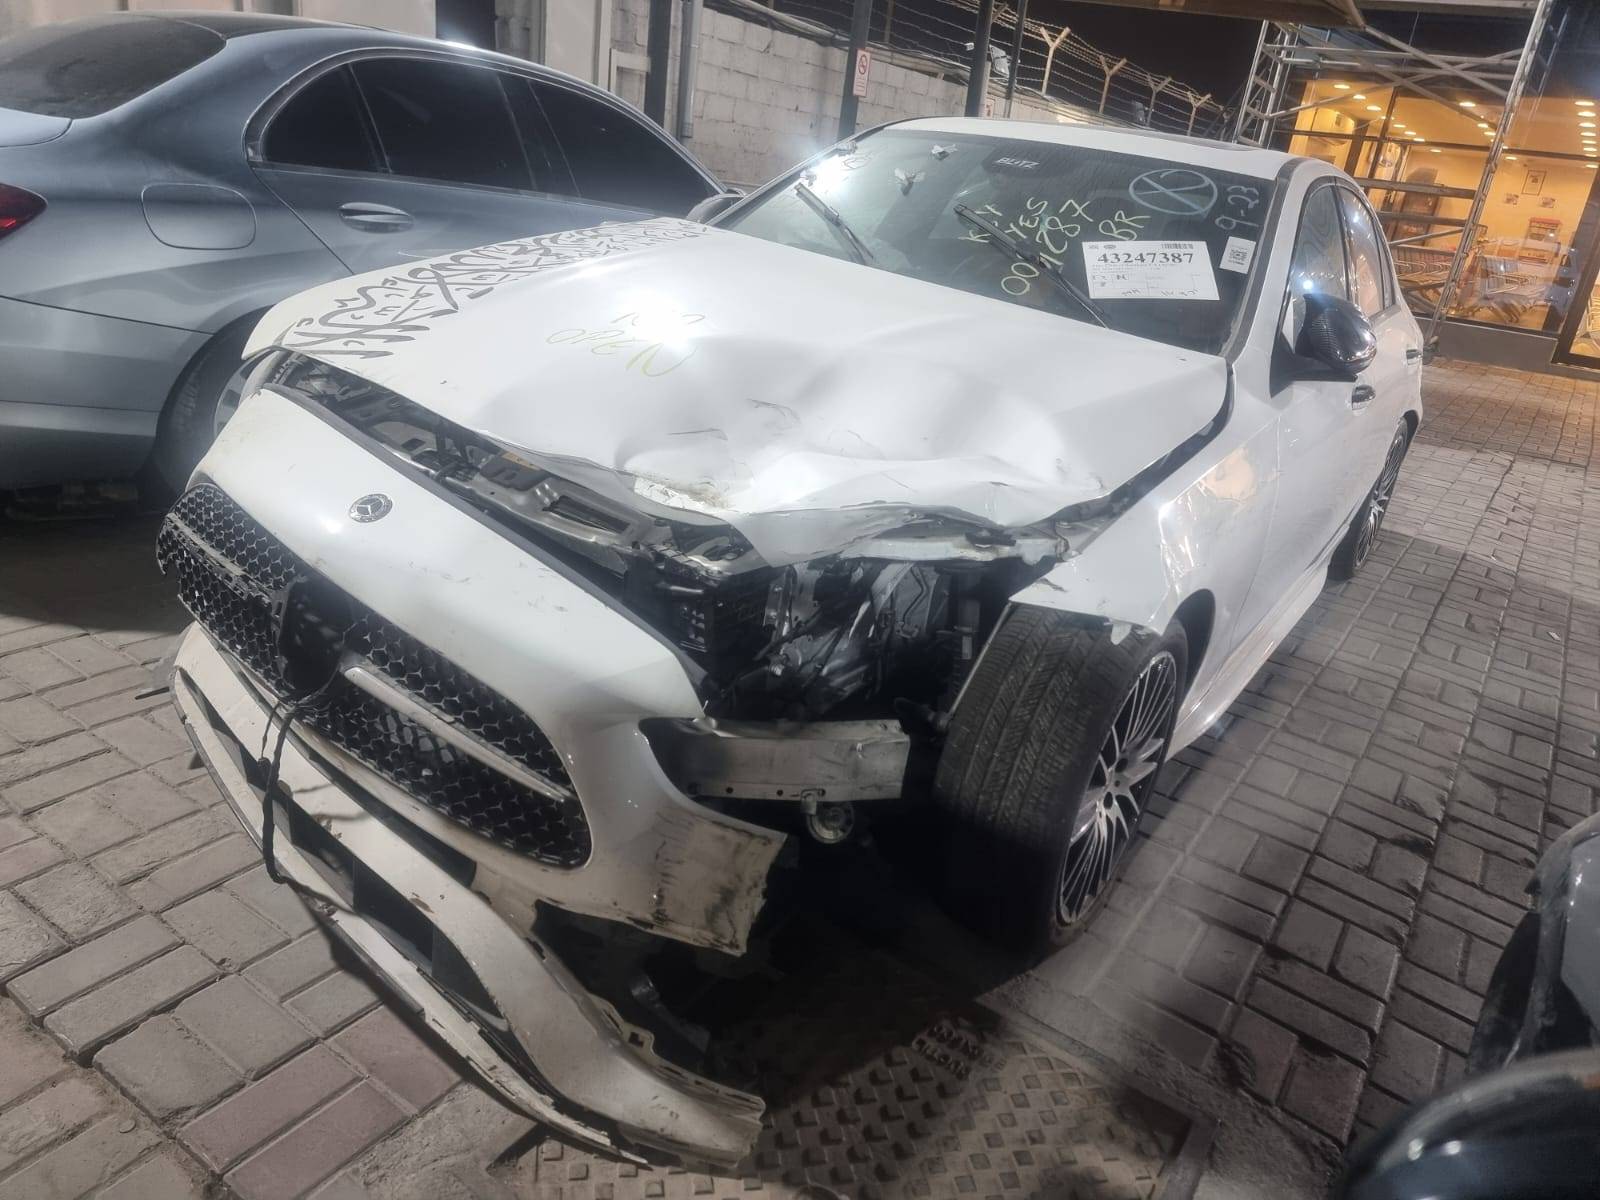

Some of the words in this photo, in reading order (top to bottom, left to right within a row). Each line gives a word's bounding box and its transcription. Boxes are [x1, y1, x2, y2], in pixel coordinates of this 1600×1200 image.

[994, 156, 1041, 169] BLITZ
[957, 202, 1003, 243] KY
[1002, 196, 1049, 239] YES
[1098, 210, 1151, 242] BR
[1097, 252, 1194, 264] 43247387
